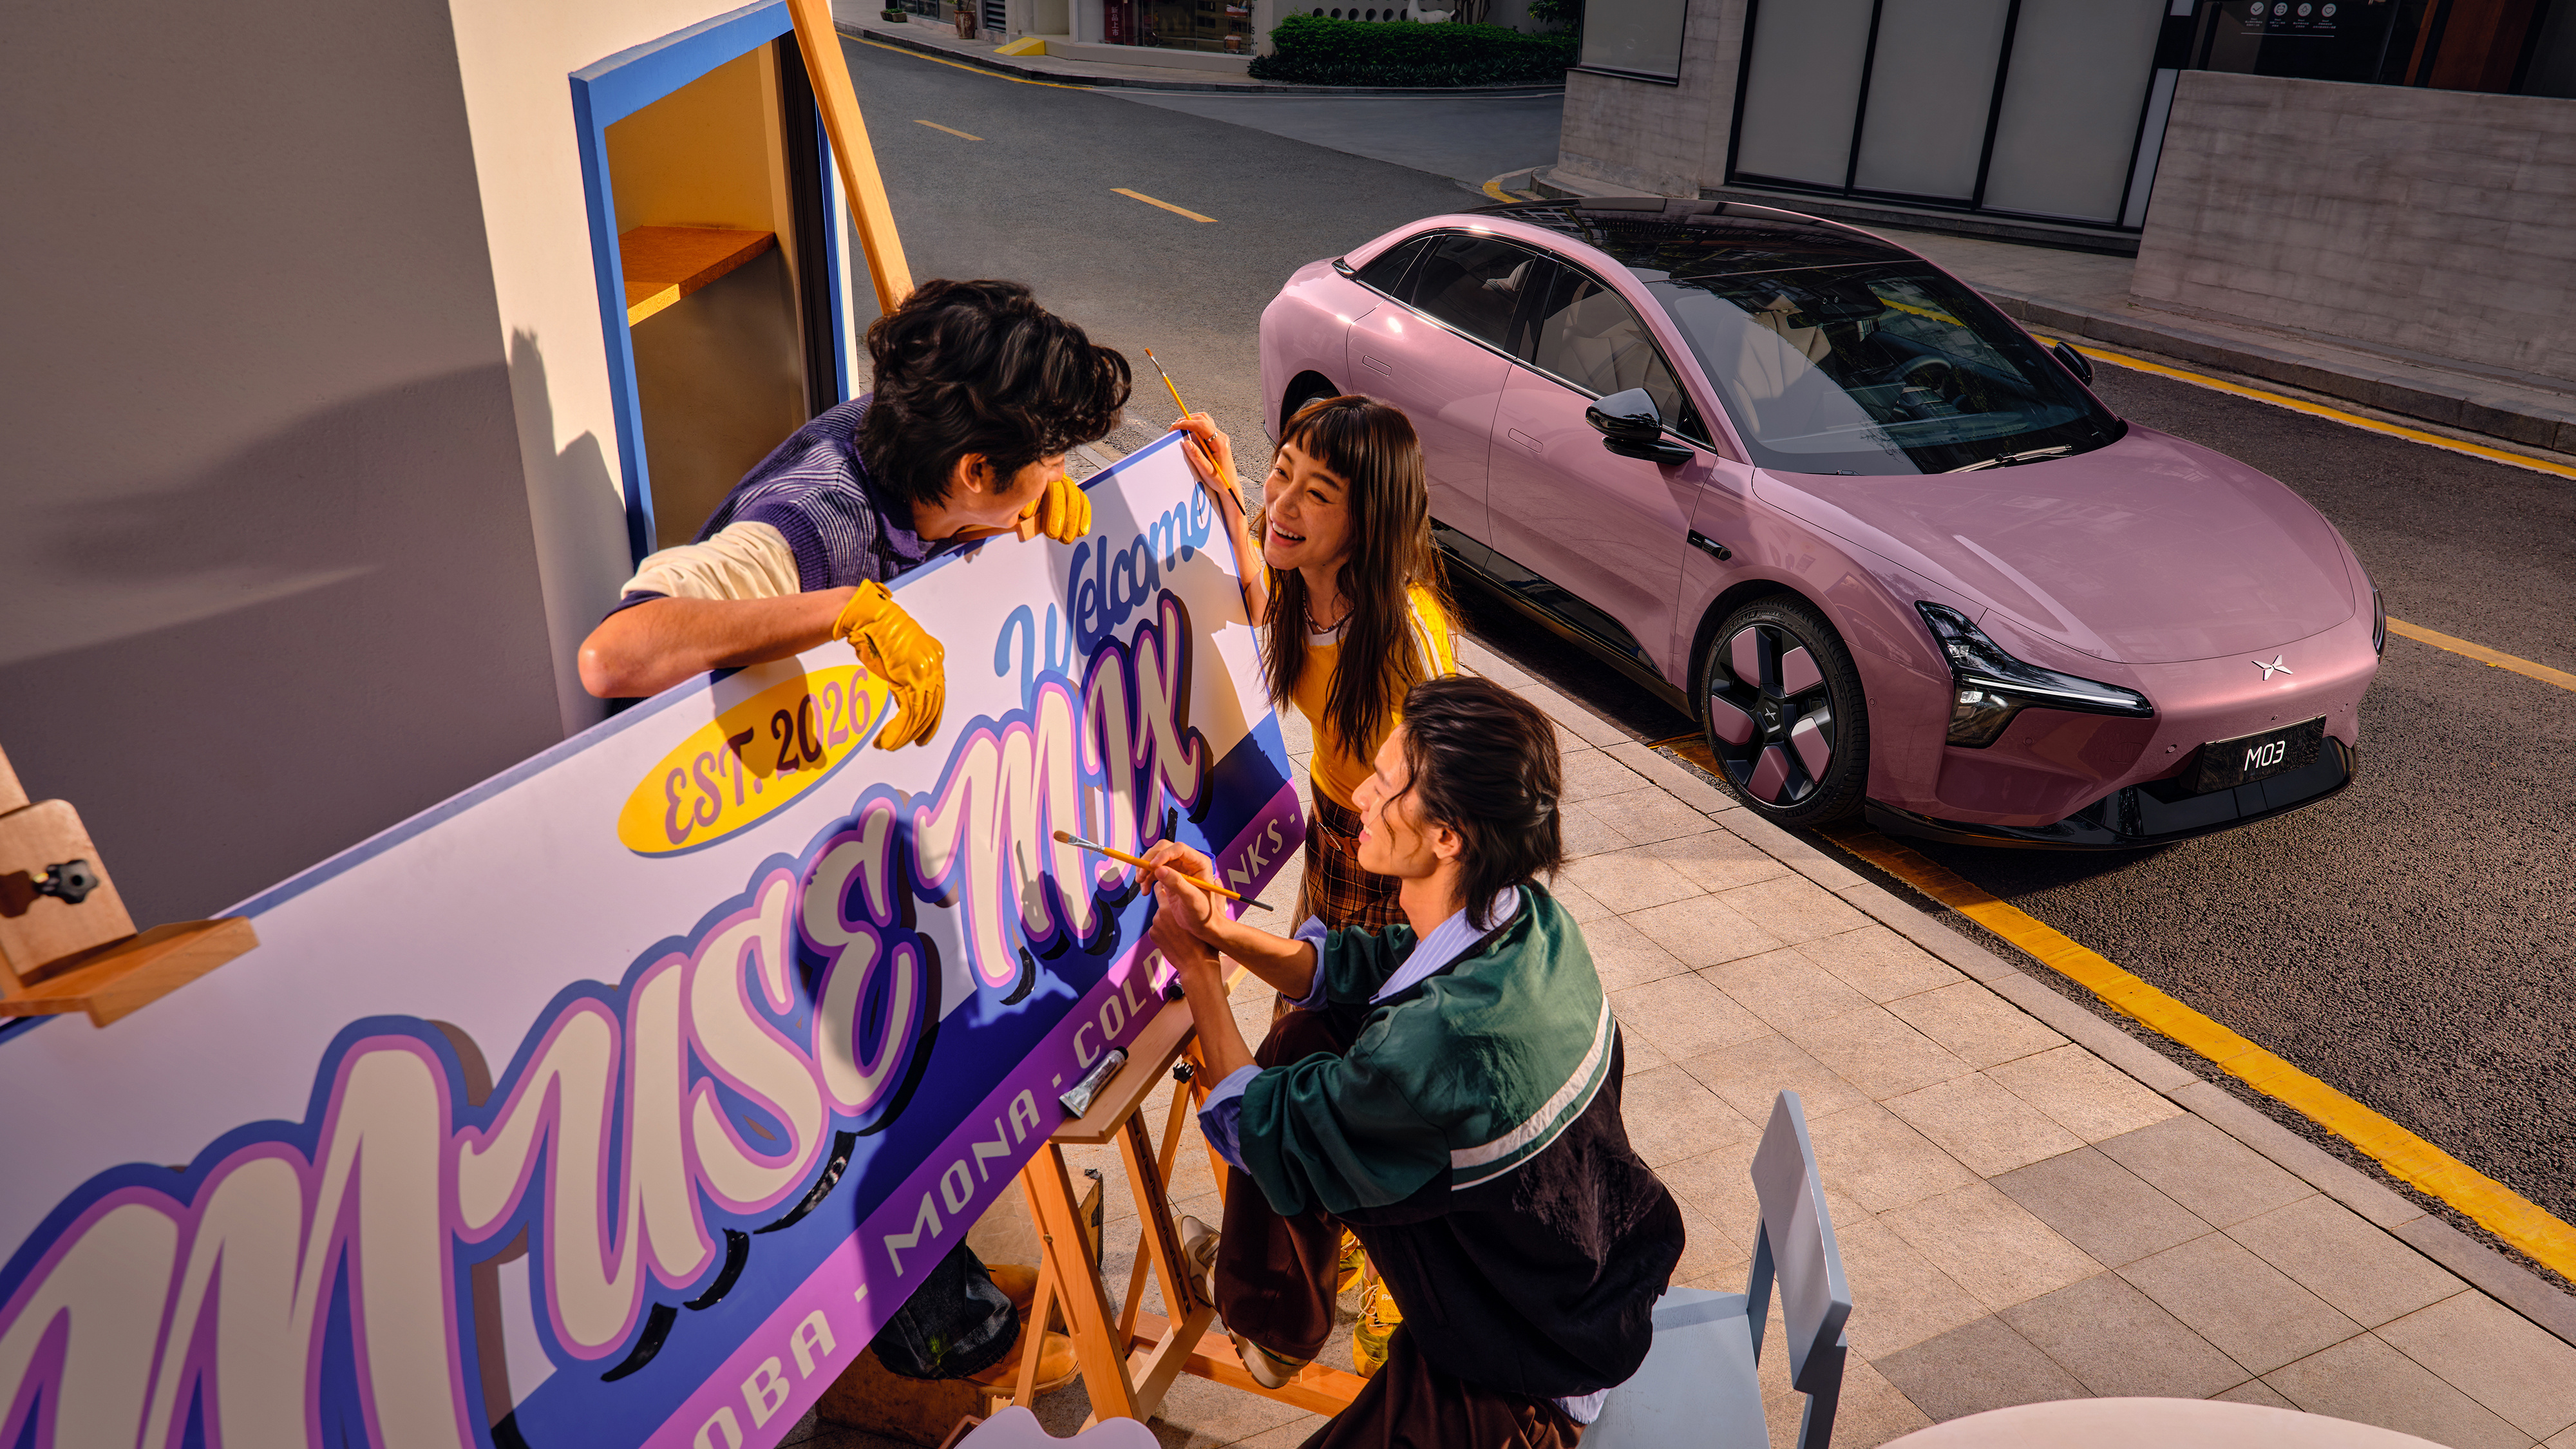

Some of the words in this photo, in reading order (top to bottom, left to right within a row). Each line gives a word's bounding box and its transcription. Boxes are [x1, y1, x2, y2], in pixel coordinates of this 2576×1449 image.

[1111, 6, 1119, 36] 新品上市
[994, 480, 1212, 712] Welcome
[1722, 610, 1758, 638] MICHELIN
[665, 725, 764, 845] EST.
[770, 668, 871, 782] 2026
[2244, 740, 2286, 771] M03
[0, 796, 923, 1449] MUSE
[912, 592, 1202, 989] MIX
[883, 1088, 1041, 1278] MONA
[1073, 947, 1168, 1069] COLD
